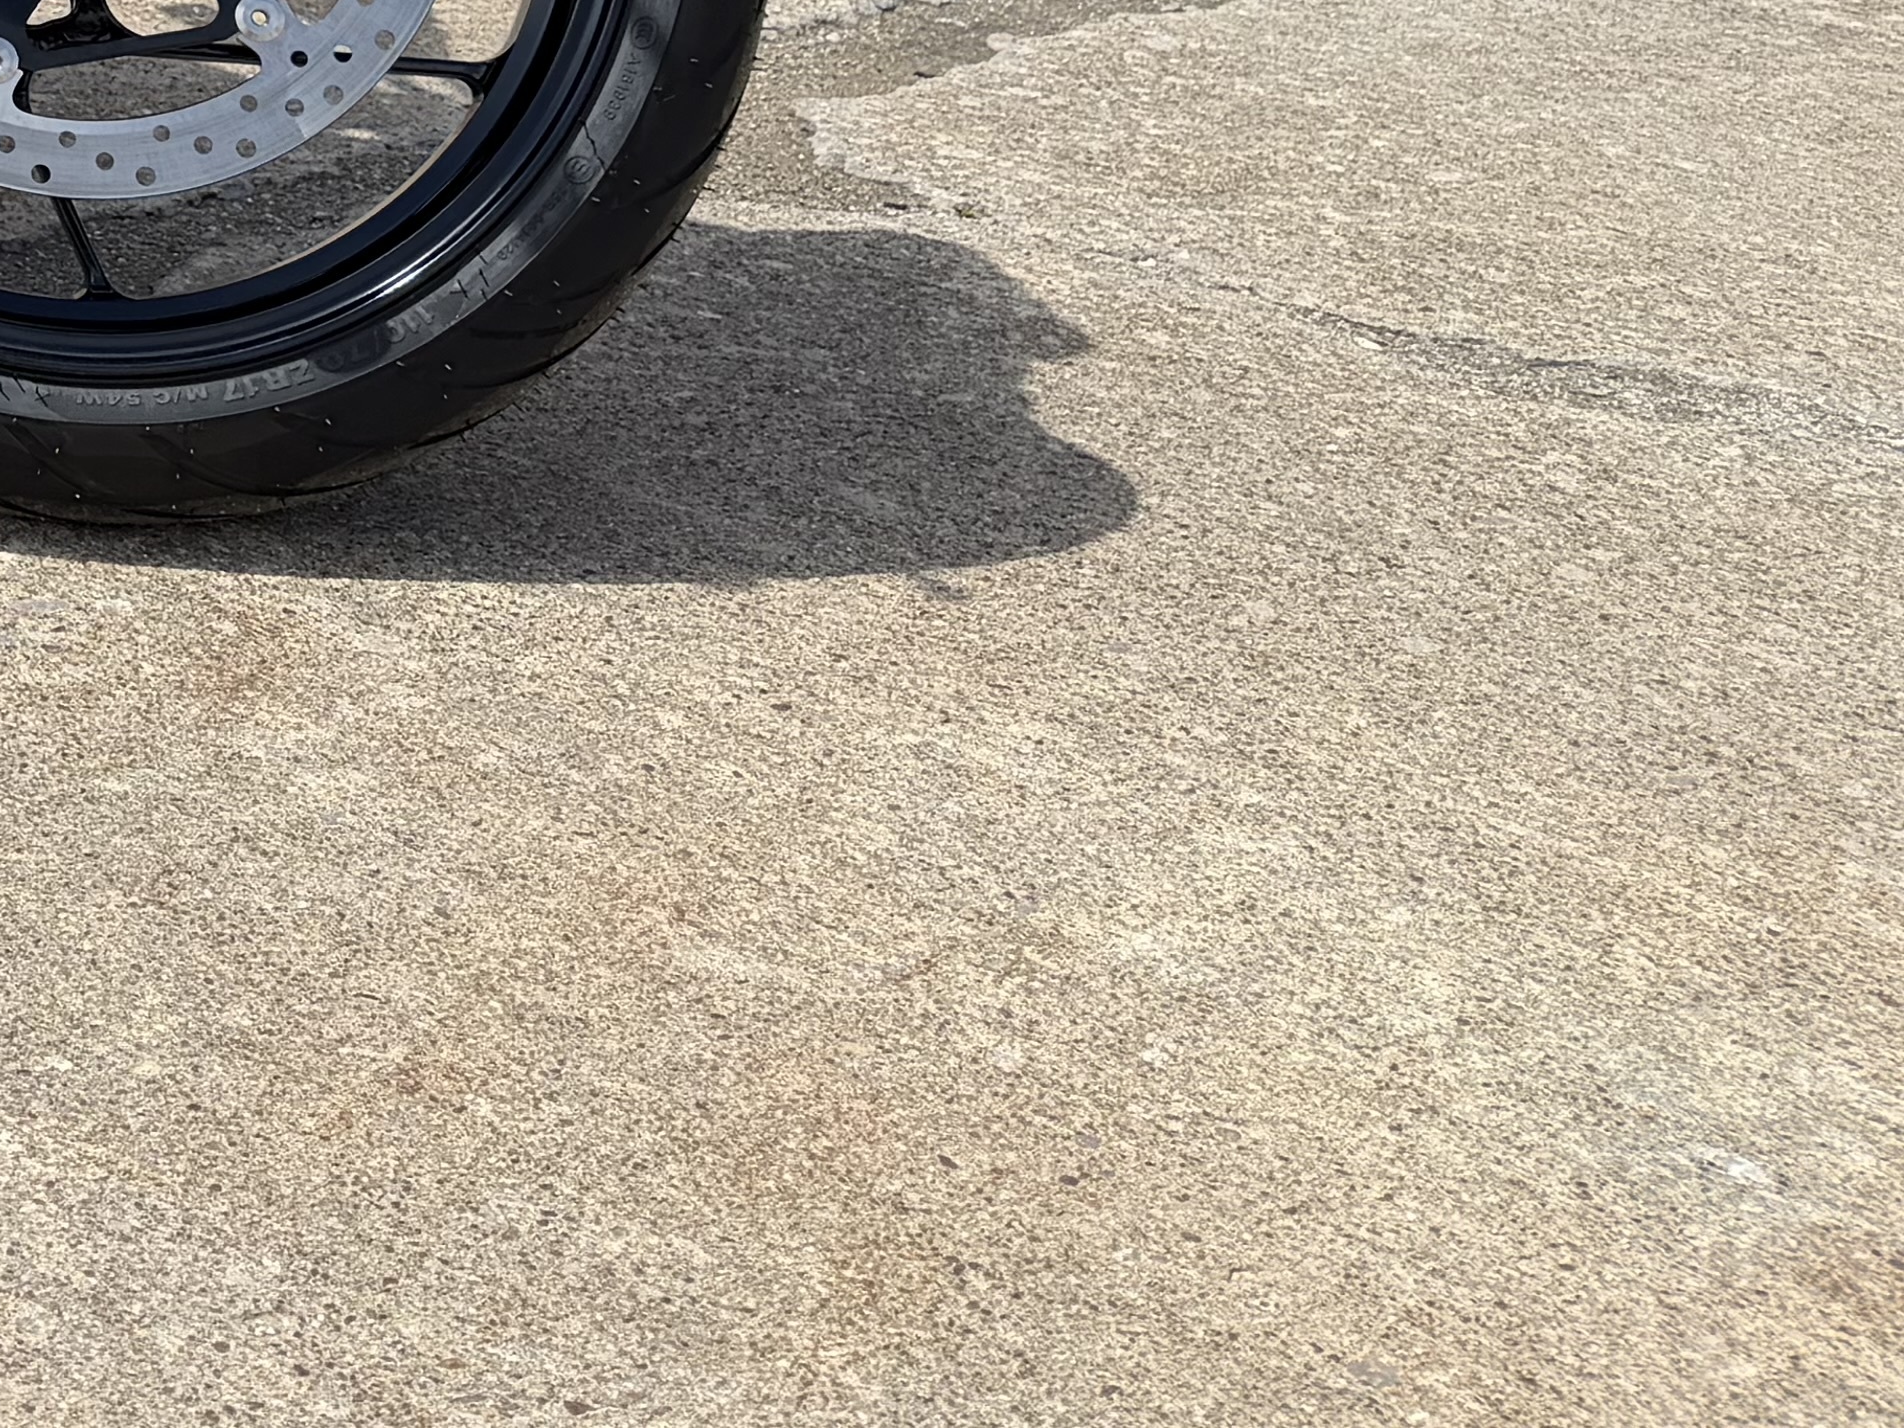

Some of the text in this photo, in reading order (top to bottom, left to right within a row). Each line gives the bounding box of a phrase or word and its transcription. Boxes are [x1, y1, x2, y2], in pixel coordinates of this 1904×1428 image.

[221, 357, 316, 401] ZR17
[74, 390, 142, 407] 54W
[151, 384, 210, 406] M/C
